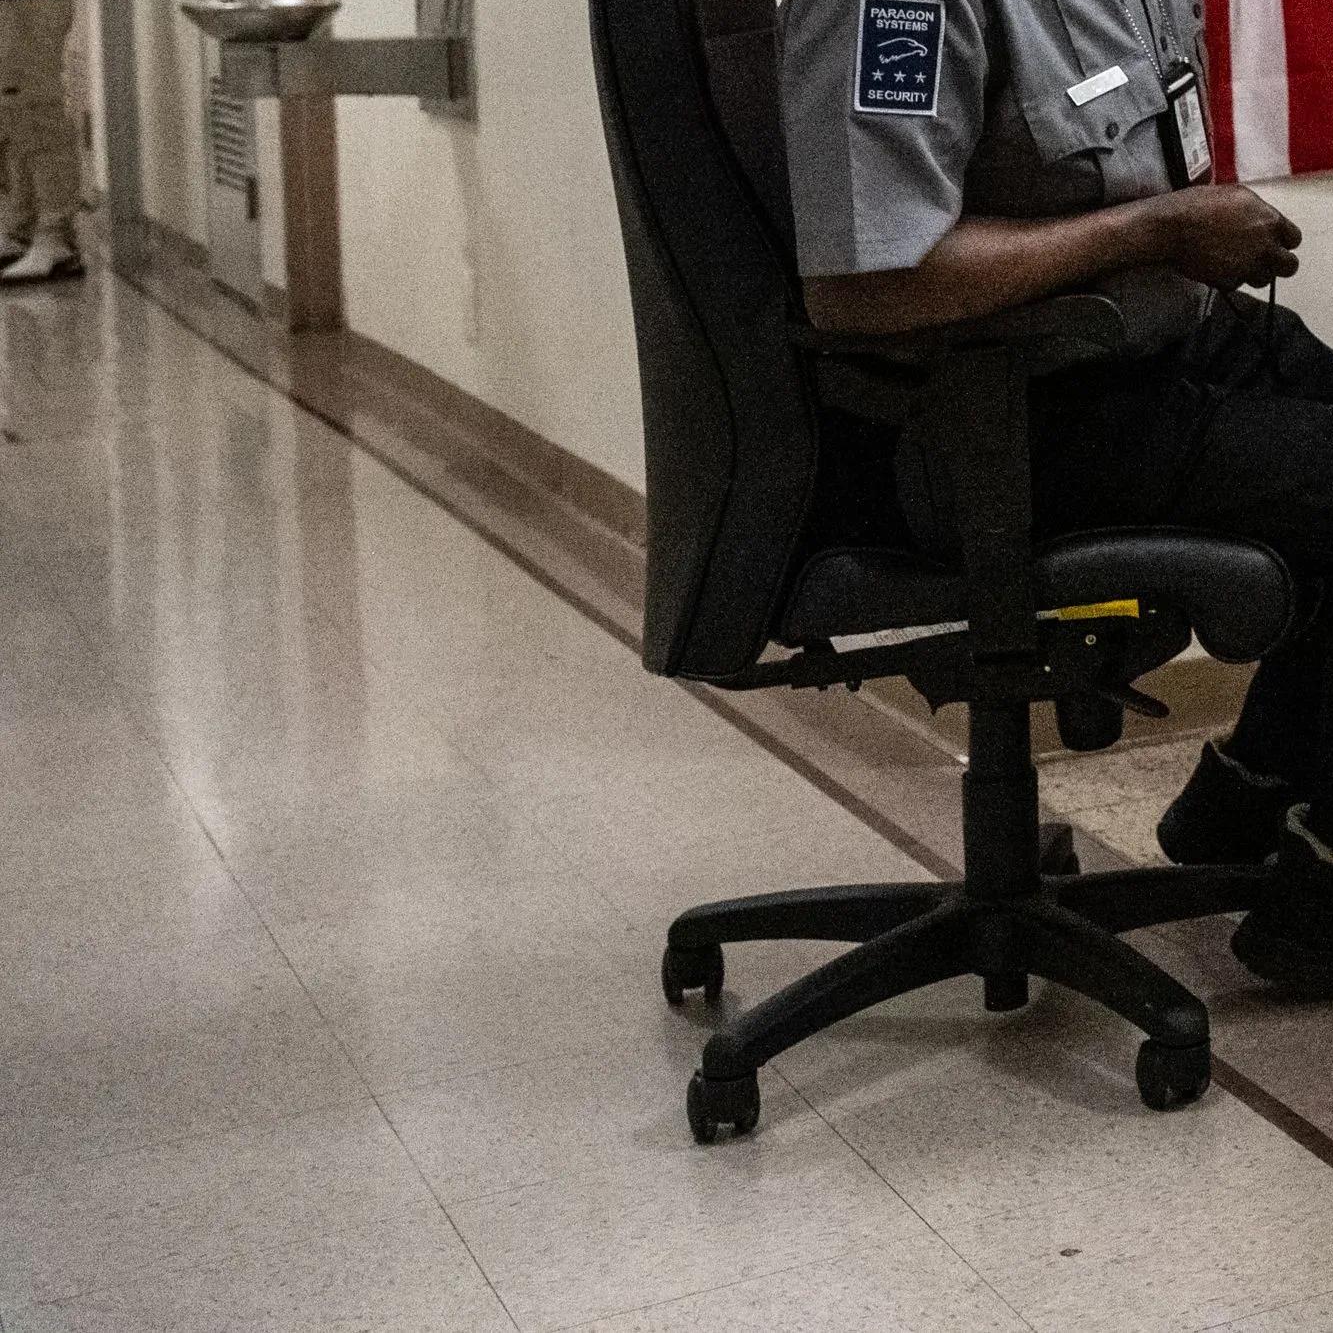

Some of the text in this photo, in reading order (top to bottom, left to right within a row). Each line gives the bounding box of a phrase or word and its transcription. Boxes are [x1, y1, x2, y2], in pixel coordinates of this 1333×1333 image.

[870, 7, 935, 22] PARAGON
[876, 19, 929, 32] SYSTEMS
[867, 89, 928, 103] SECURITY
